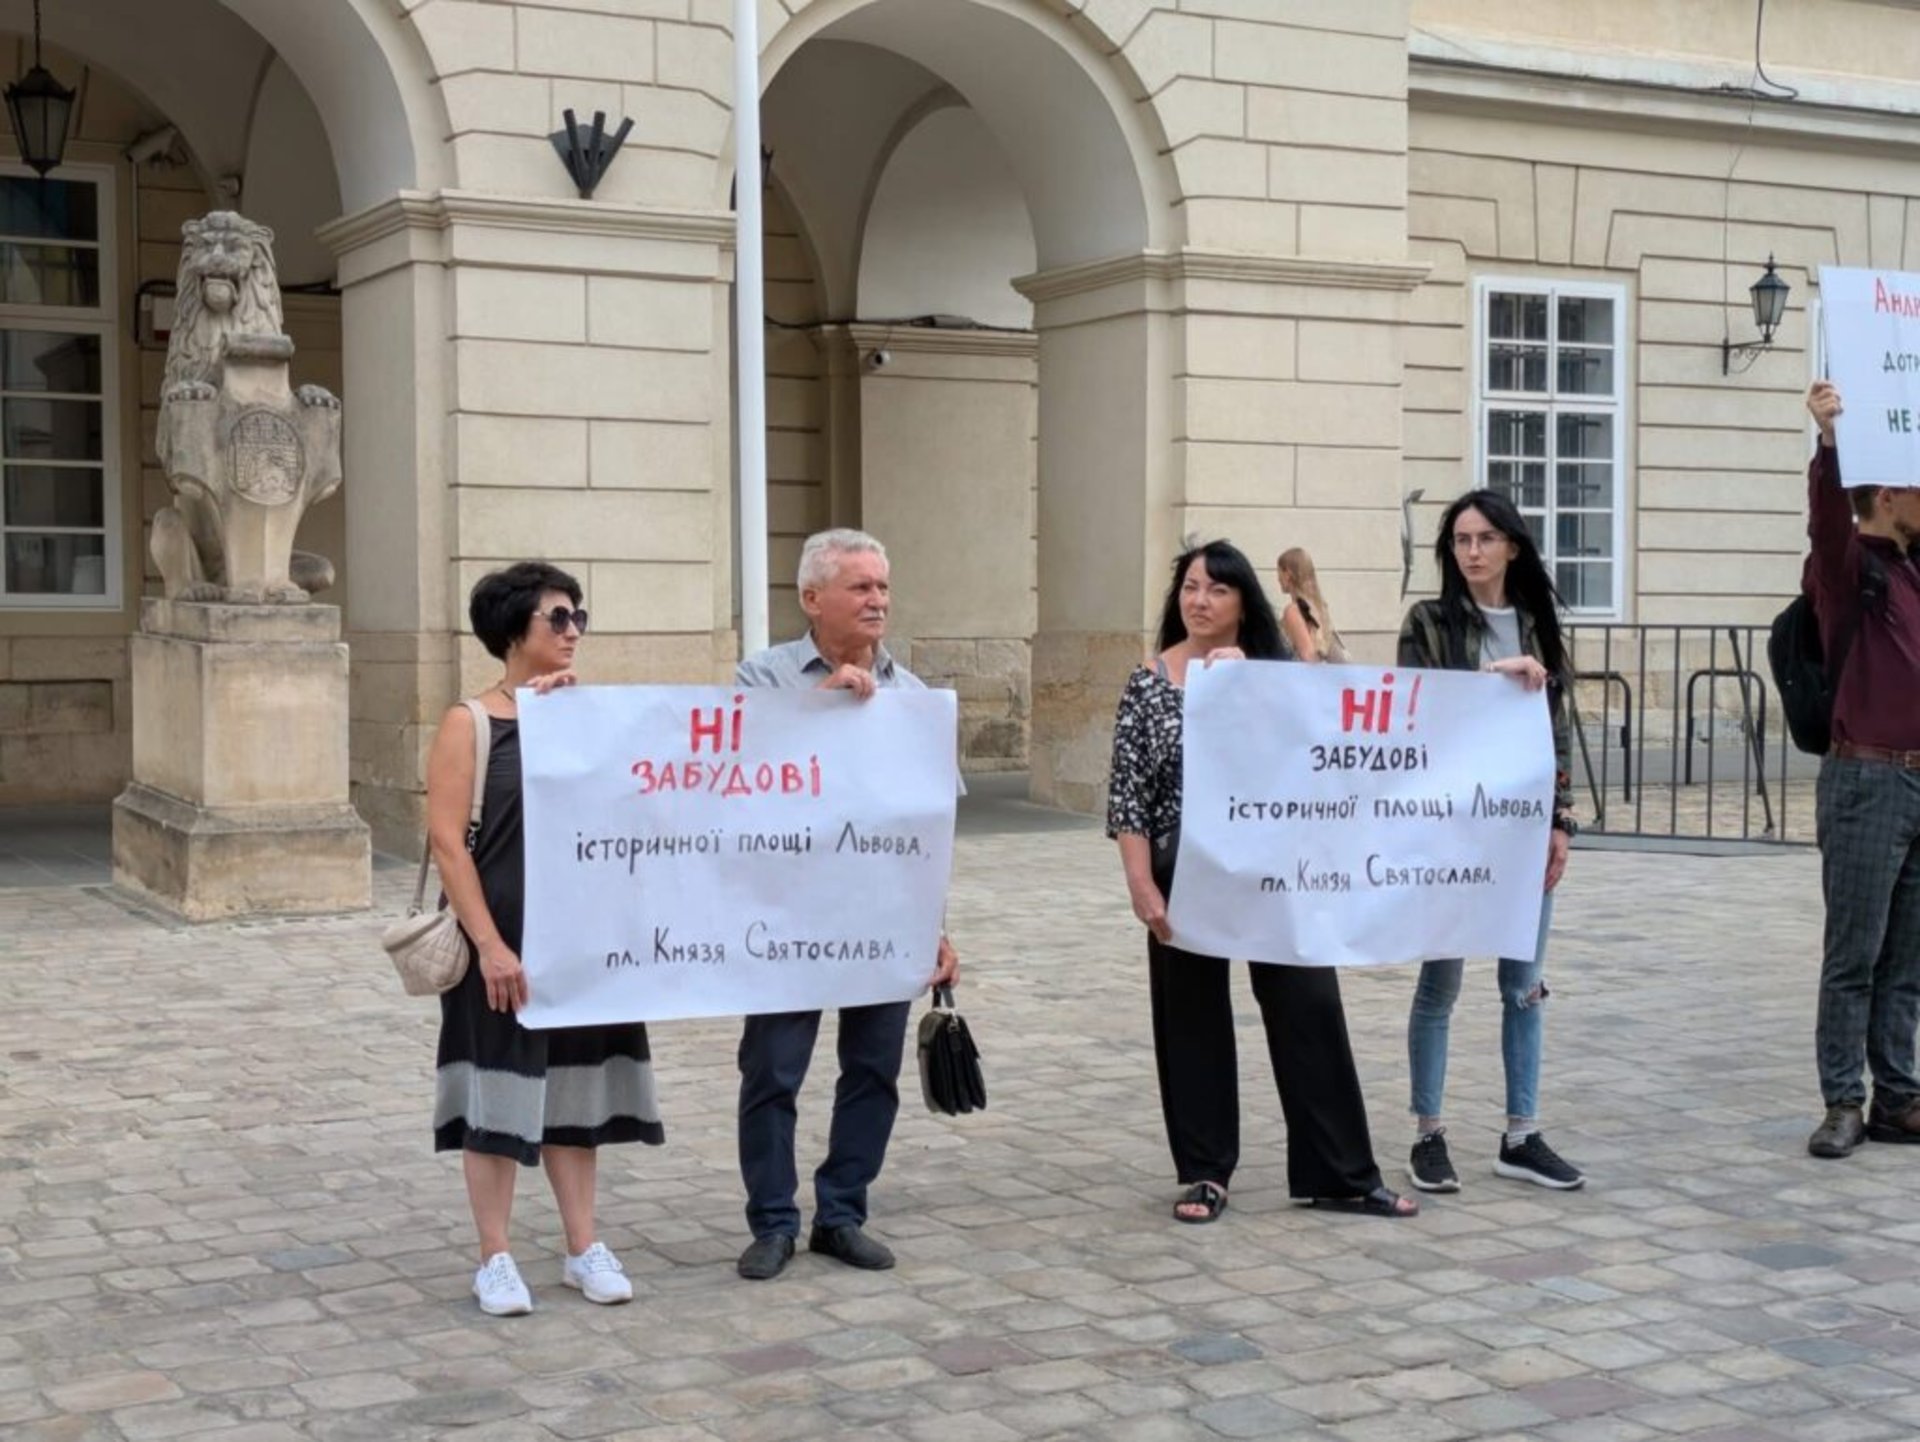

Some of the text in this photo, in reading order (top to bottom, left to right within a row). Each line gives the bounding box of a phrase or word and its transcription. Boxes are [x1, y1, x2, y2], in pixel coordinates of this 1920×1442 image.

[1887, 408, 1911, 433] НЕ
[1229, 794, 1358, 821] історичної
[1374, 793, 1454, 821] площі
[576, 829, 722, 875] історичної
[739, 826, 811, 855] площі
[1297, 858, 1351, 892] Князя
[654, 926, 725, 964] Князя
